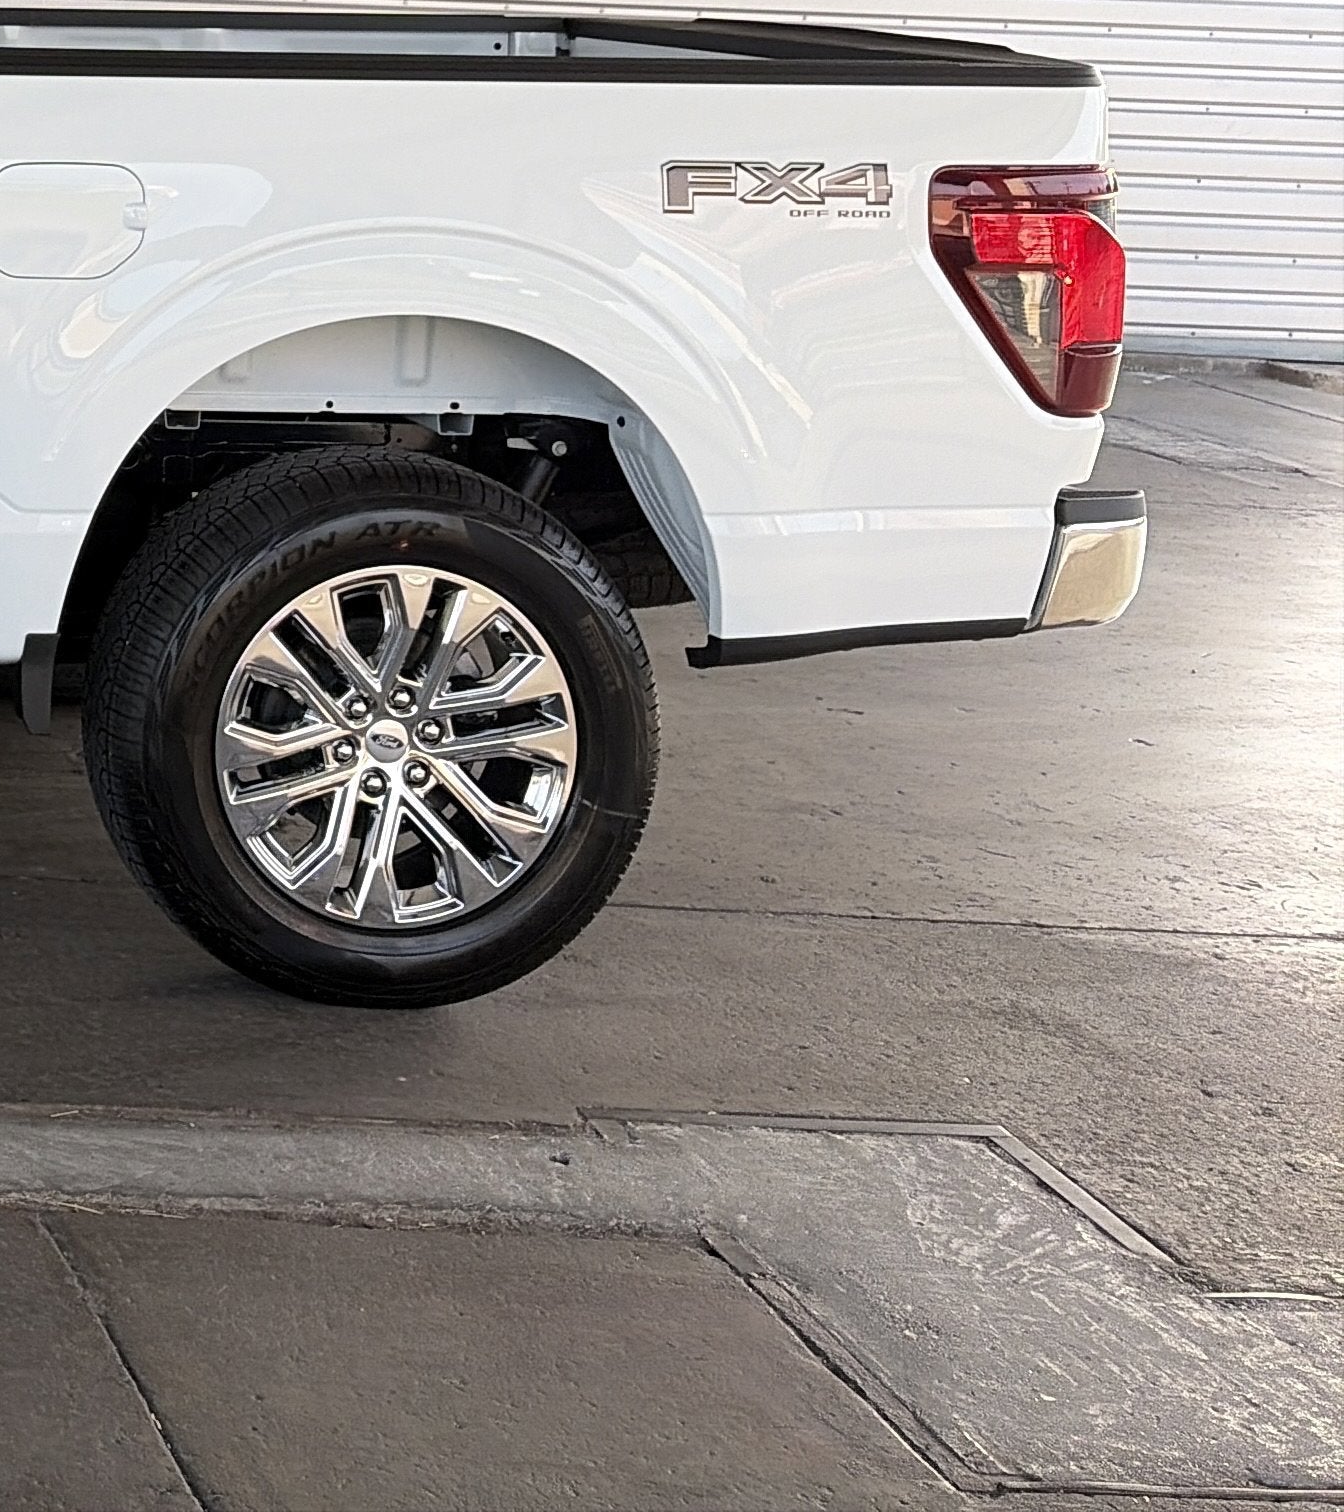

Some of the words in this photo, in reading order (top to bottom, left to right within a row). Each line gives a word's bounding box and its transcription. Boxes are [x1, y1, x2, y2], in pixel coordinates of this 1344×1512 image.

[661, 160, 893, 215] FX4
[788, 208, 830, 219] OFF
[837, 209, 891, 219] ROAD
[356, 520, 443, 540] ATR
